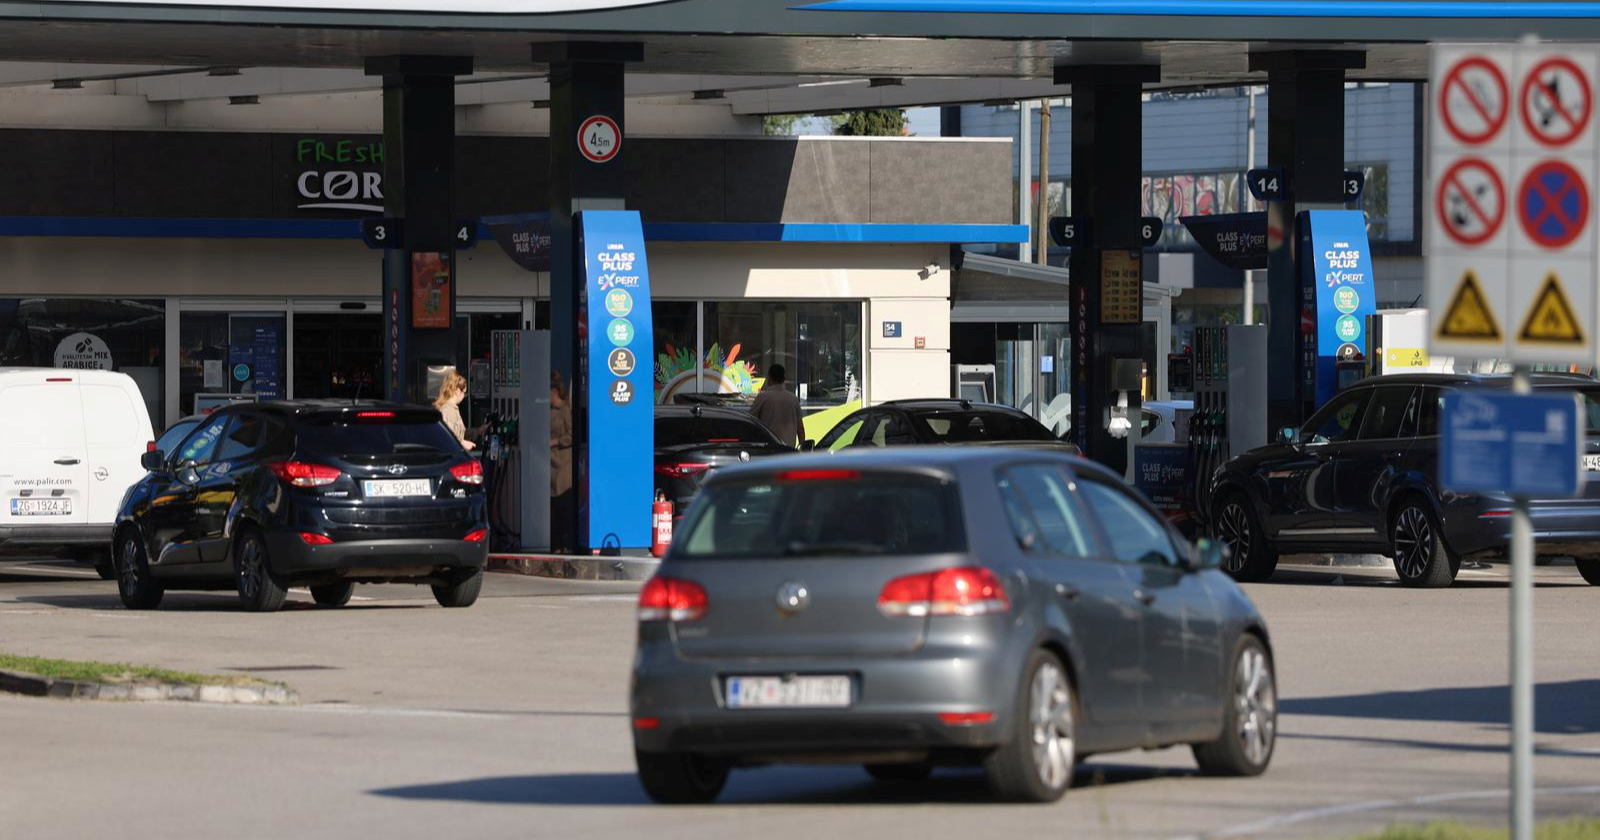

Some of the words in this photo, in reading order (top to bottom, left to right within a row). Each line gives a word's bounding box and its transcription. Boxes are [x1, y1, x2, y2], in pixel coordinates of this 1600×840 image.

[1257, 177, 1279, 193] 14
[375, 226, 386, 240] 3
[457, 227, 468, 241] 4
[1064, 224, 1075, 239] 5
[1142, 224, 1152, 239] 6
[512, 232, 529, 243] CLASS
[1216, 232, 1238, 242] CLASS
[1240, 232, 1265, 252] EXPERT
[515, 243, 529, 253] PLUS
[1220, 242, 1237, 251] PLUS
[598, 252, 635, 262] CLASS
[1325, 251, 1360, 260] CLASS
[602, 262, 633, 271] PLUS
[1329, 260, 1358, 268] PLUS
[598, 272, 640, 291] EXPERT
[1325, 270, 1364, 287] EXPERT
[1339, 291, 1353, 299] 100
[886, 323, 896, 331] 54
[1342, 320, 1354, 328] 95
[94, 351, 109, 359] MIX
[617, 352, 626, 360] D
[1345, 347, 1353, 355] D
[62, 361, 98, 369] ARABICE
[616, 381, 627, 392] D
[1142, 463, 1161, 472] CLASS
[13, 477, 72, 486] www.palir.com
[1144, 472, 1159, 481] PLUS
[373, 482, 384, 494] SK
[19, 500, 30, 511] ZG
